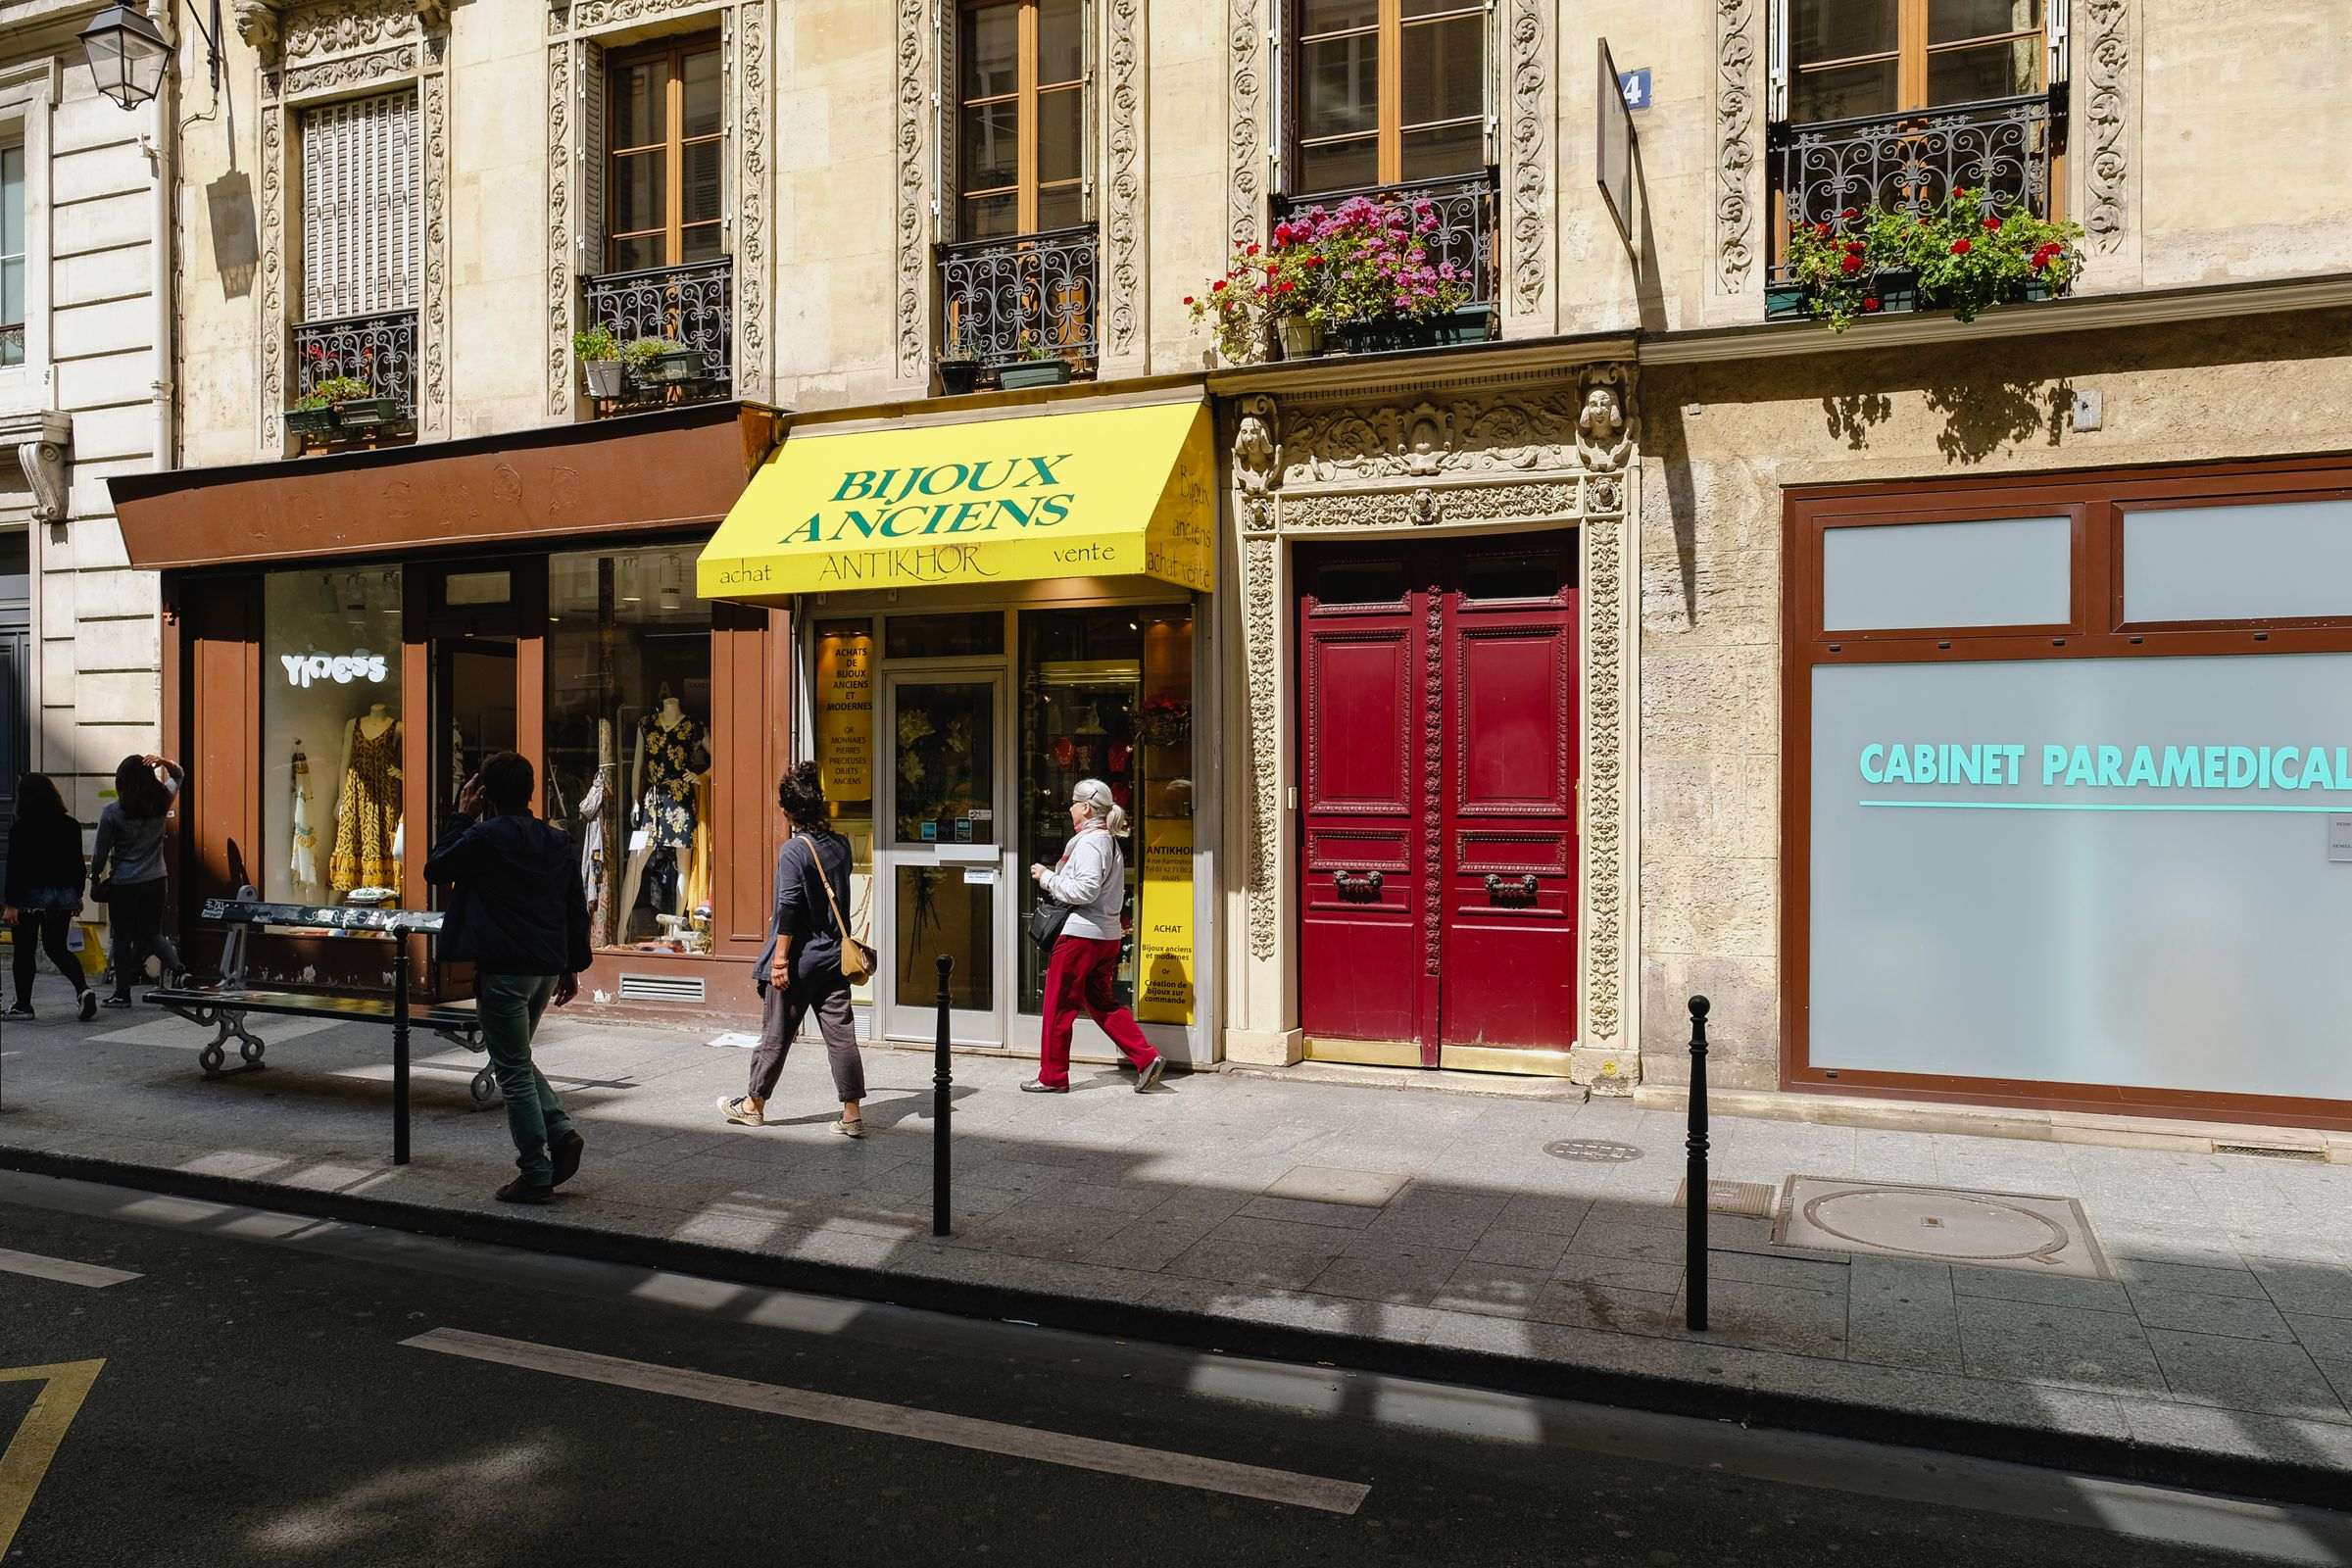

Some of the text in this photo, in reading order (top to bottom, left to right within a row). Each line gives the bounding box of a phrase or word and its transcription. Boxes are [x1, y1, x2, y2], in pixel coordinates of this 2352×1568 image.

[1623, 74, 1642, 104] 4
[827, 454, 1073, 505] BIJOUX
[777, 494, 1074, 545] ANCIENS
[1173, 519, 1211, 548] anciens
[719, 543, 1114, 584] achat ANTIKHOR vente
[1147, 542, 1210, 588] achat vente
[835, 648, 867, 657] ACHATS
[837, 670, 865, 678] BIJOUX
[827, 702, 872, 710] MODERNES
[1860, 743, 2352, 790] CABINET PARAMEDICAL
[1153, 925, 1183, 933] ACHAT
[1142, 944, 1164, 954] Bijoux
[1154, 953, 1189, 961] modernes
[1147, 987, 1172, 996] bijoux
[1145, 996, 1186, 1004] commande
